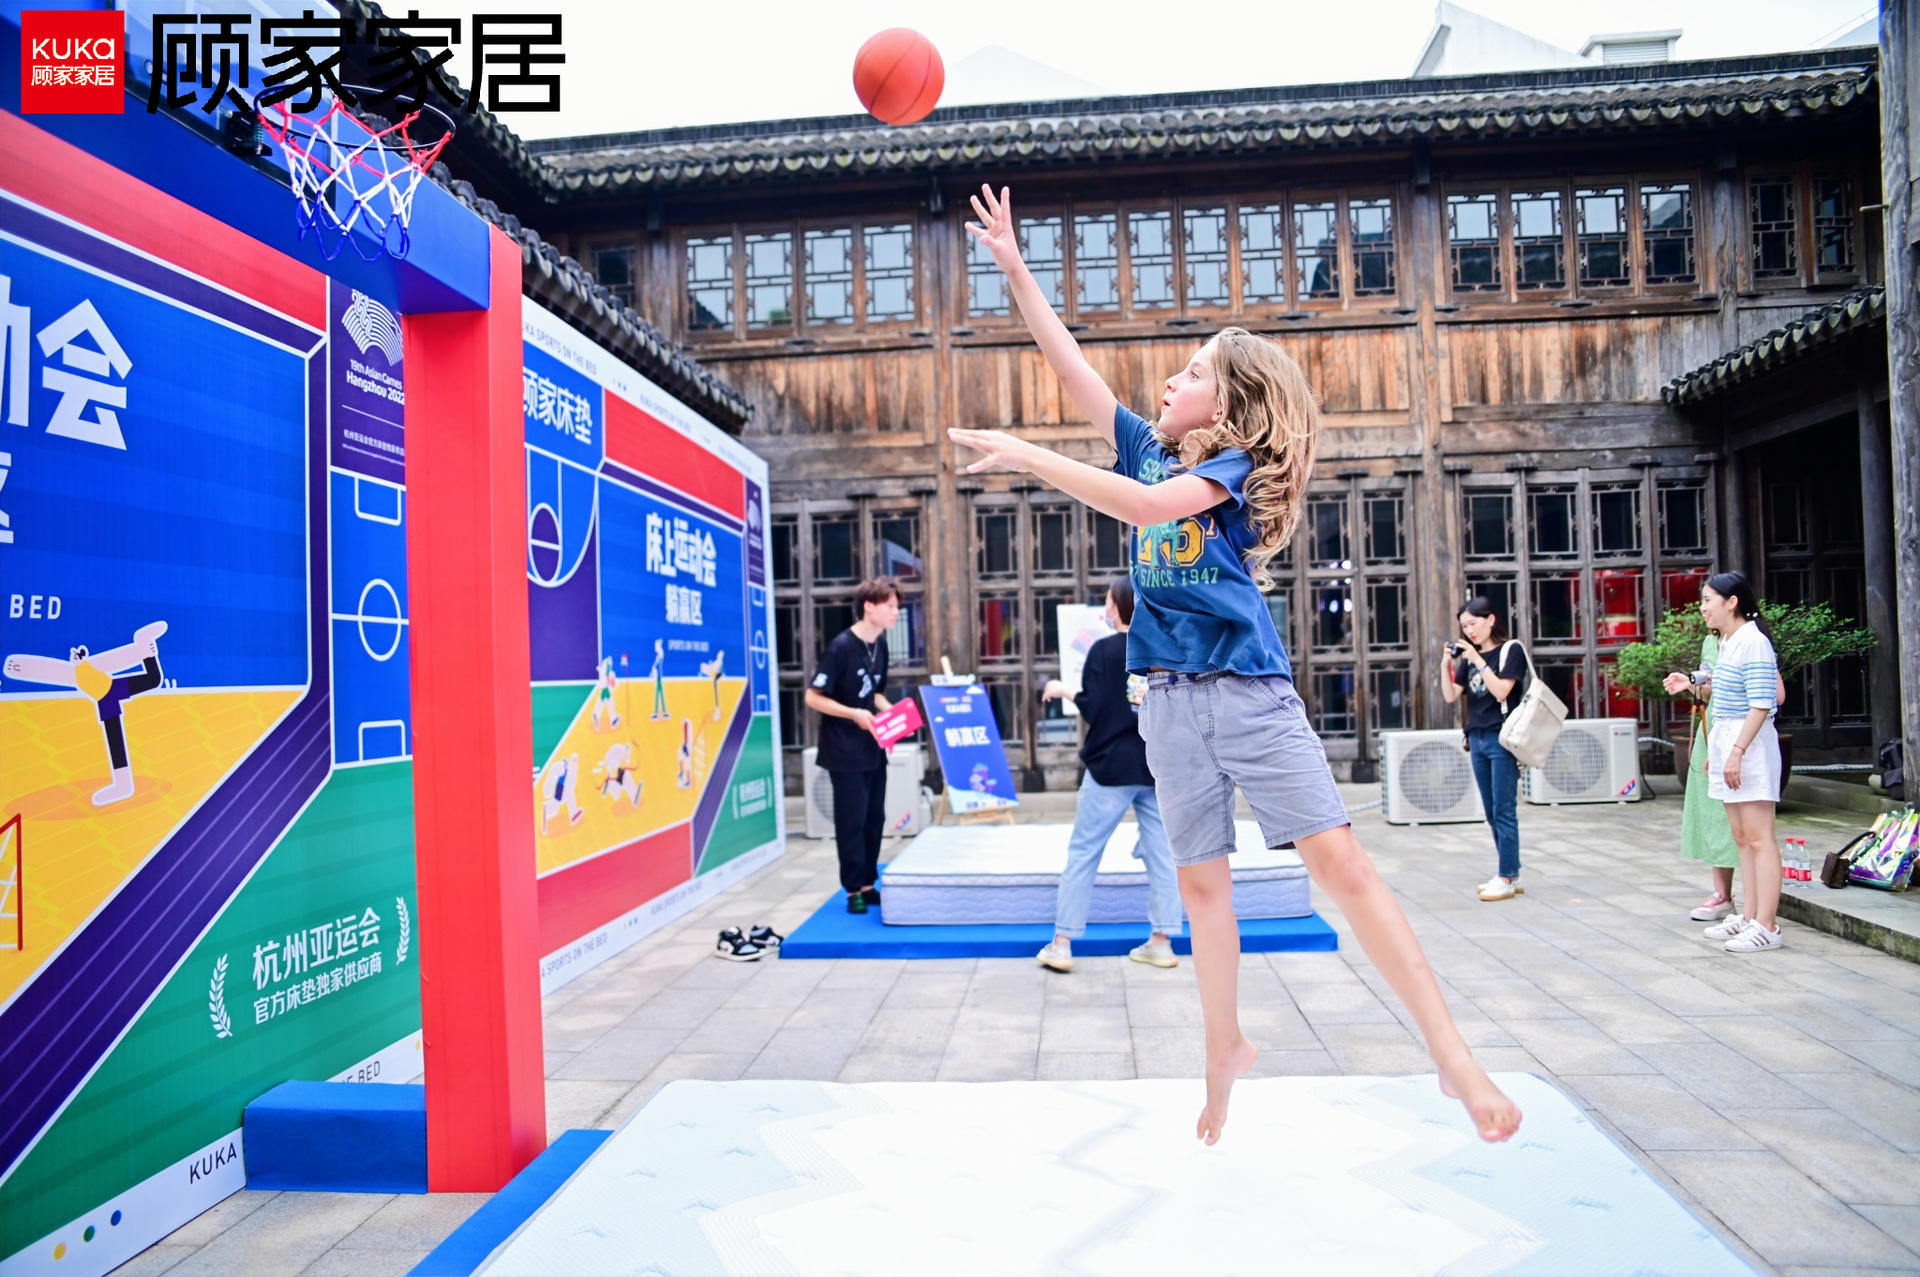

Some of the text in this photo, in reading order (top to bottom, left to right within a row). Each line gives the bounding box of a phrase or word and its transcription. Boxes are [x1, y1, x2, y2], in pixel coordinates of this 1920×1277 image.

[346, 370, 405, 406] Hangzhou 2022
[646, 512, 717, 587] 床上运动会
[1140, 567, 1175, 588] SINCE
[1181, 567, 1219, 586] 1947
[9, 594, 62, 619] BED
[252, 907, 382, 990] 杭州亚运会
[253, 952, 383, 1025] 官方床垫独家供应商
[358, 1060, 381, 1084] BED
[189, 1141, 238, 1184] KUKA
